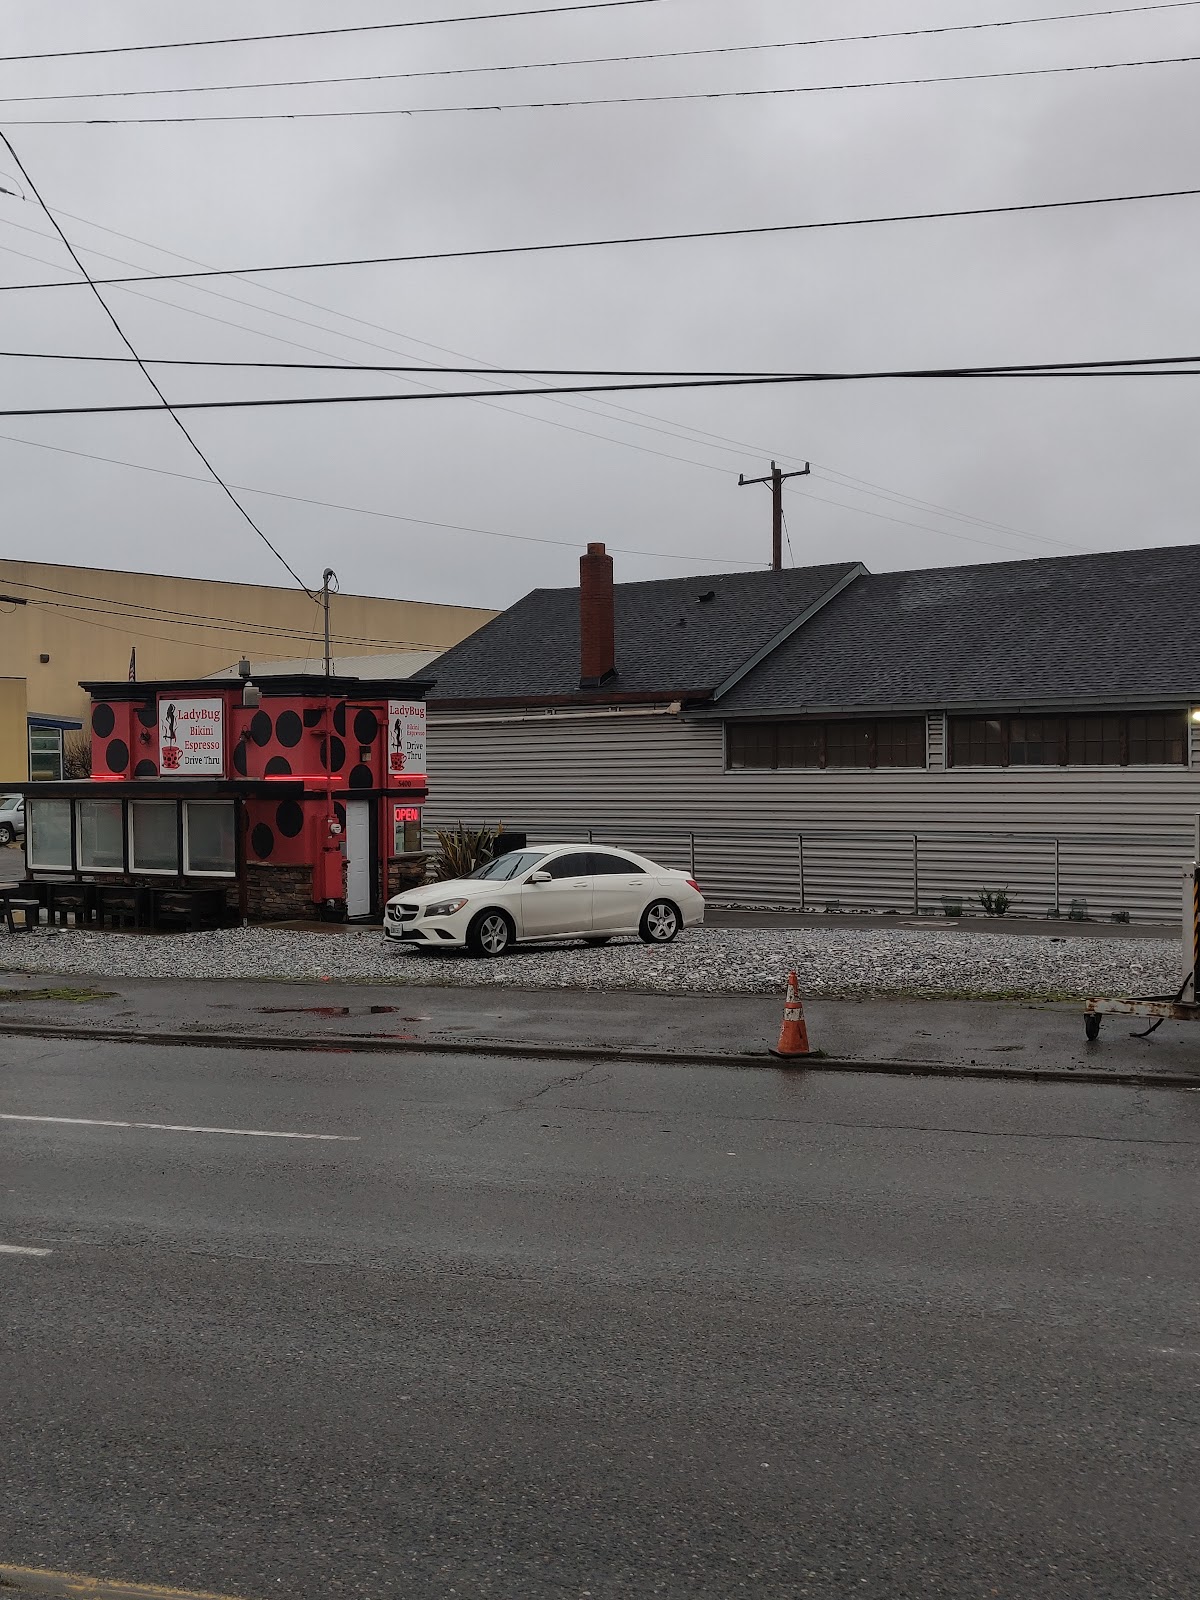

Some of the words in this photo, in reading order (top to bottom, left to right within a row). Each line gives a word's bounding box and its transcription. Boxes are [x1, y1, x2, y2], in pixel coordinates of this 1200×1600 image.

[178, 709, 220, 722] LadyBug
[390, 705, 425, 718] LadyBug
[190, 725, 213, 736] Bikini
[185, 741, 220, 752] Espresso
[406, 741, 423, 750] Drive
[185, 756, 202, 765] Drive
[203, 756, 220, 765] Thru
[407, 751, 422, 760] Thru
[395, 808, 418, 821] OPEN
